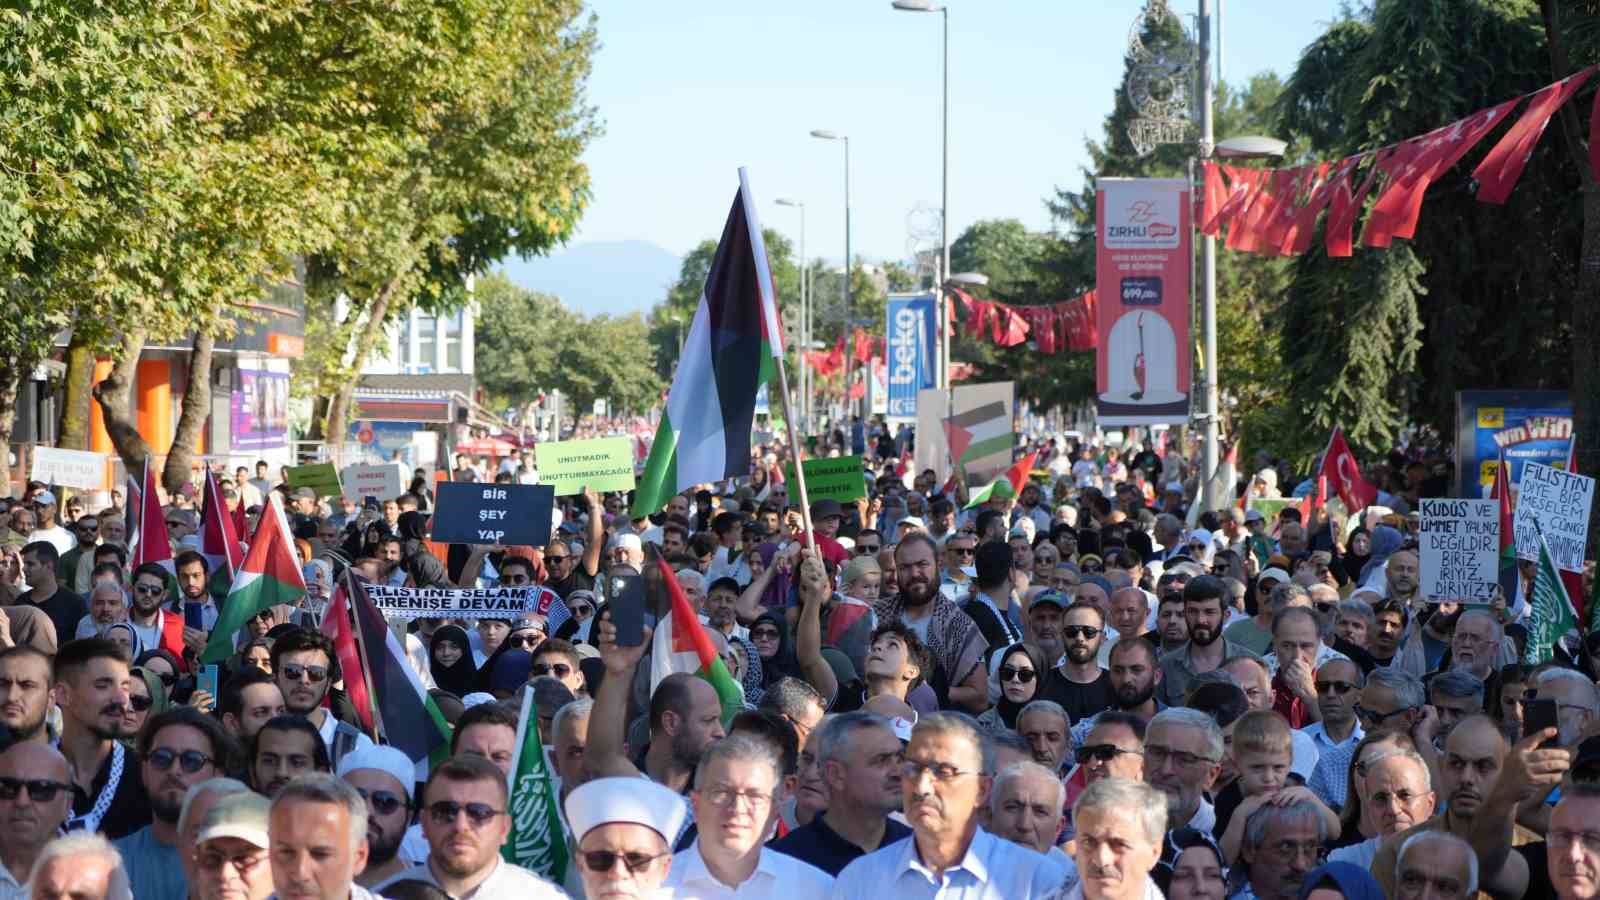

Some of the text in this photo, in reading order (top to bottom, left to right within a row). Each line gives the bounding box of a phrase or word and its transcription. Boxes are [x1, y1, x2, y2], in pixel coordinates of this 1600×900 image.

[1108, 226, 1146, 237] ZIRHLI
[890, 308, 916, 384] beko
[557, 453, 611, 465] UNUTMADIK
[482, 487, 507, 500] BİR
[479, 509, 508, 522] ŞEY
[1475, 503, 1493, 517] VE
[1420, 517, 1459, 534] ÜMMET
[478, 530, 505, 541] YAP
[461, 588, 527, 598] SELAM
[459, 598, 525, 610] DEVAM
